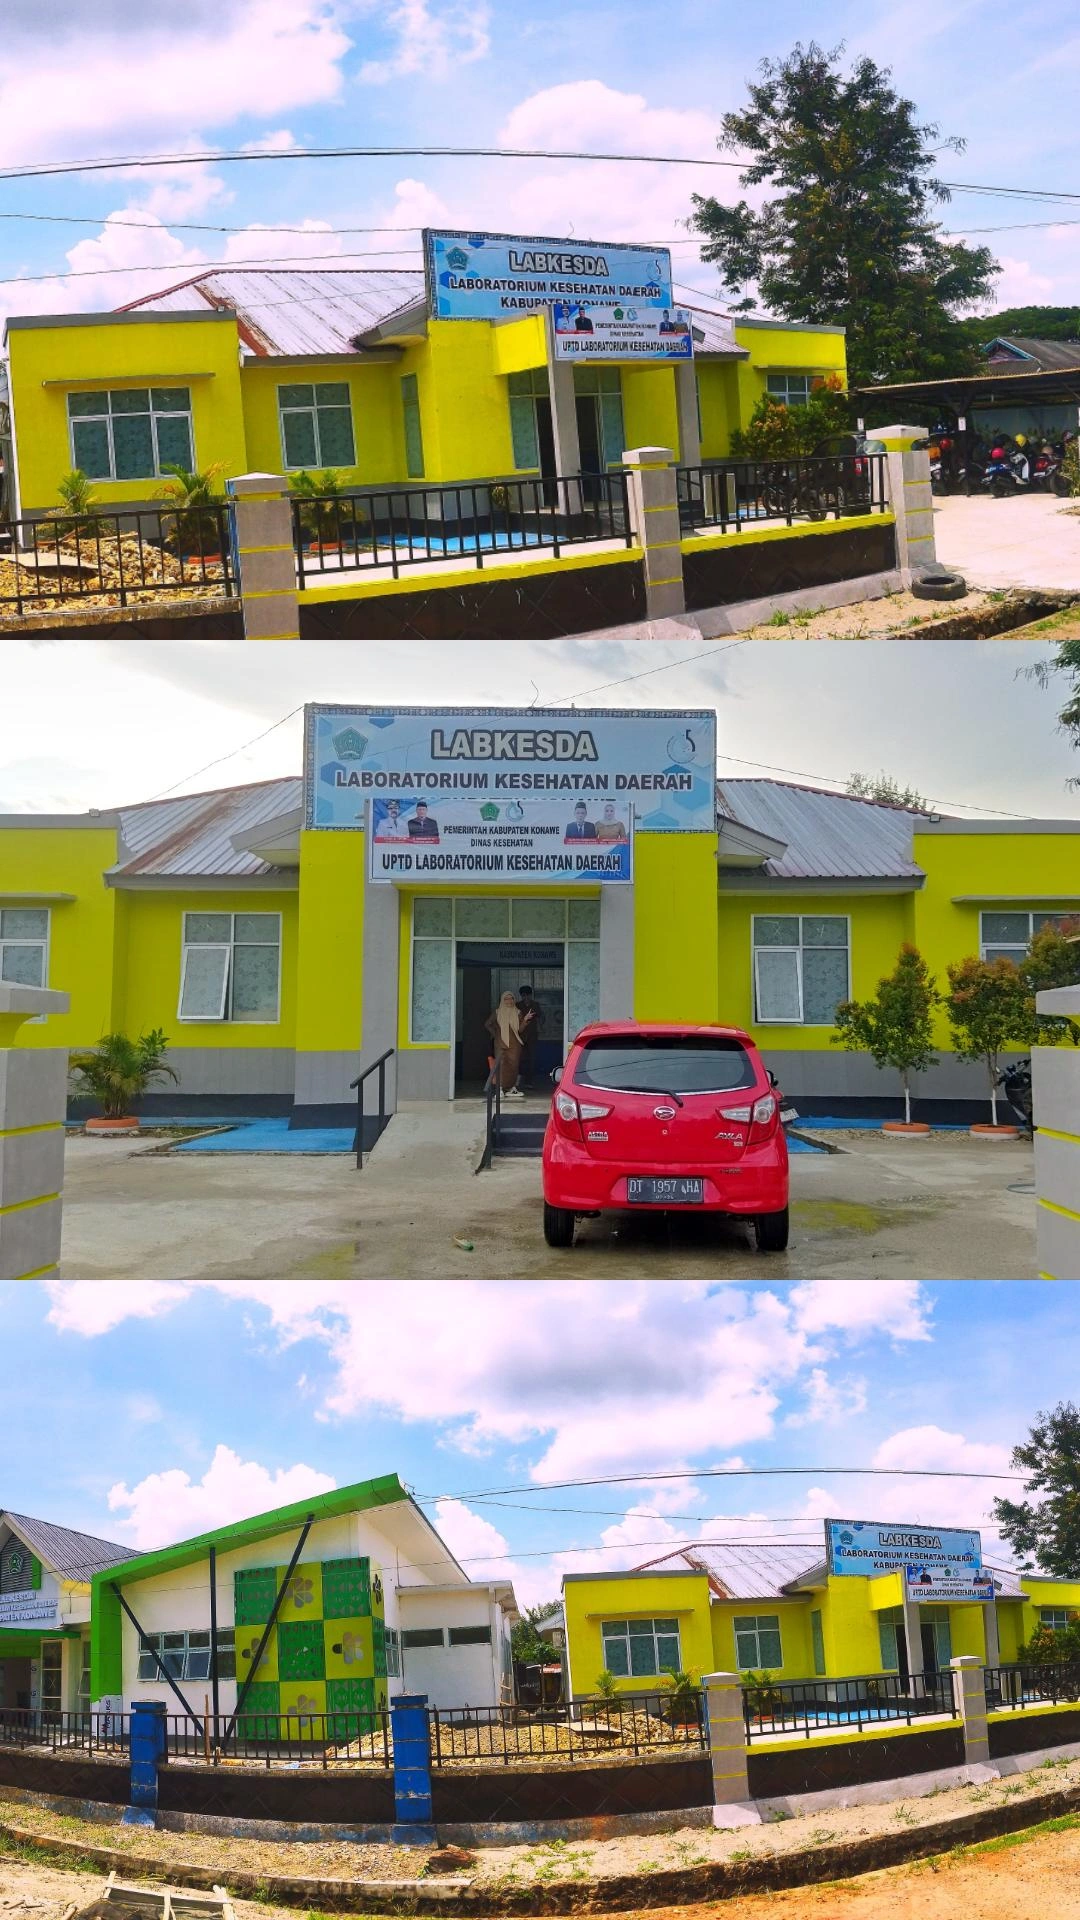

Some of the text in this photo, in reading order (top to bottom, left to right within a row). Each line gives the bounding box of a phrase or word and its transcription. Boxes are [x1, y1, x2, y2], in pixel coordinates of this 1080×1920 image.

[508, 250, 609, 277] LABKESDA
[450, 278, 661, 297] LABORATORIUM KESEHATAN DAERAH
[431, 729, 598, 762] LABKESDA
[336, 771, 692, 791] LABORATORIUM KESEHATAN DAERAH
[443, 825, 560, 835] PEMERINTAH KABUPATEN KONAWE
[471, 839, 533, 847] DINAS KESEHATAN
[382, 853, 621, 871] UPTD LABORATORIUM KESEHATAN DAERAH
[629, 1179, 643, 1193] DT
[652, 1180, 677, 1193] 1957
[878, 1532, 942, 1549] LABKESDA
[842, 1549, 975, 1562] LABORATORIUM KESEHATAN DAERAH
